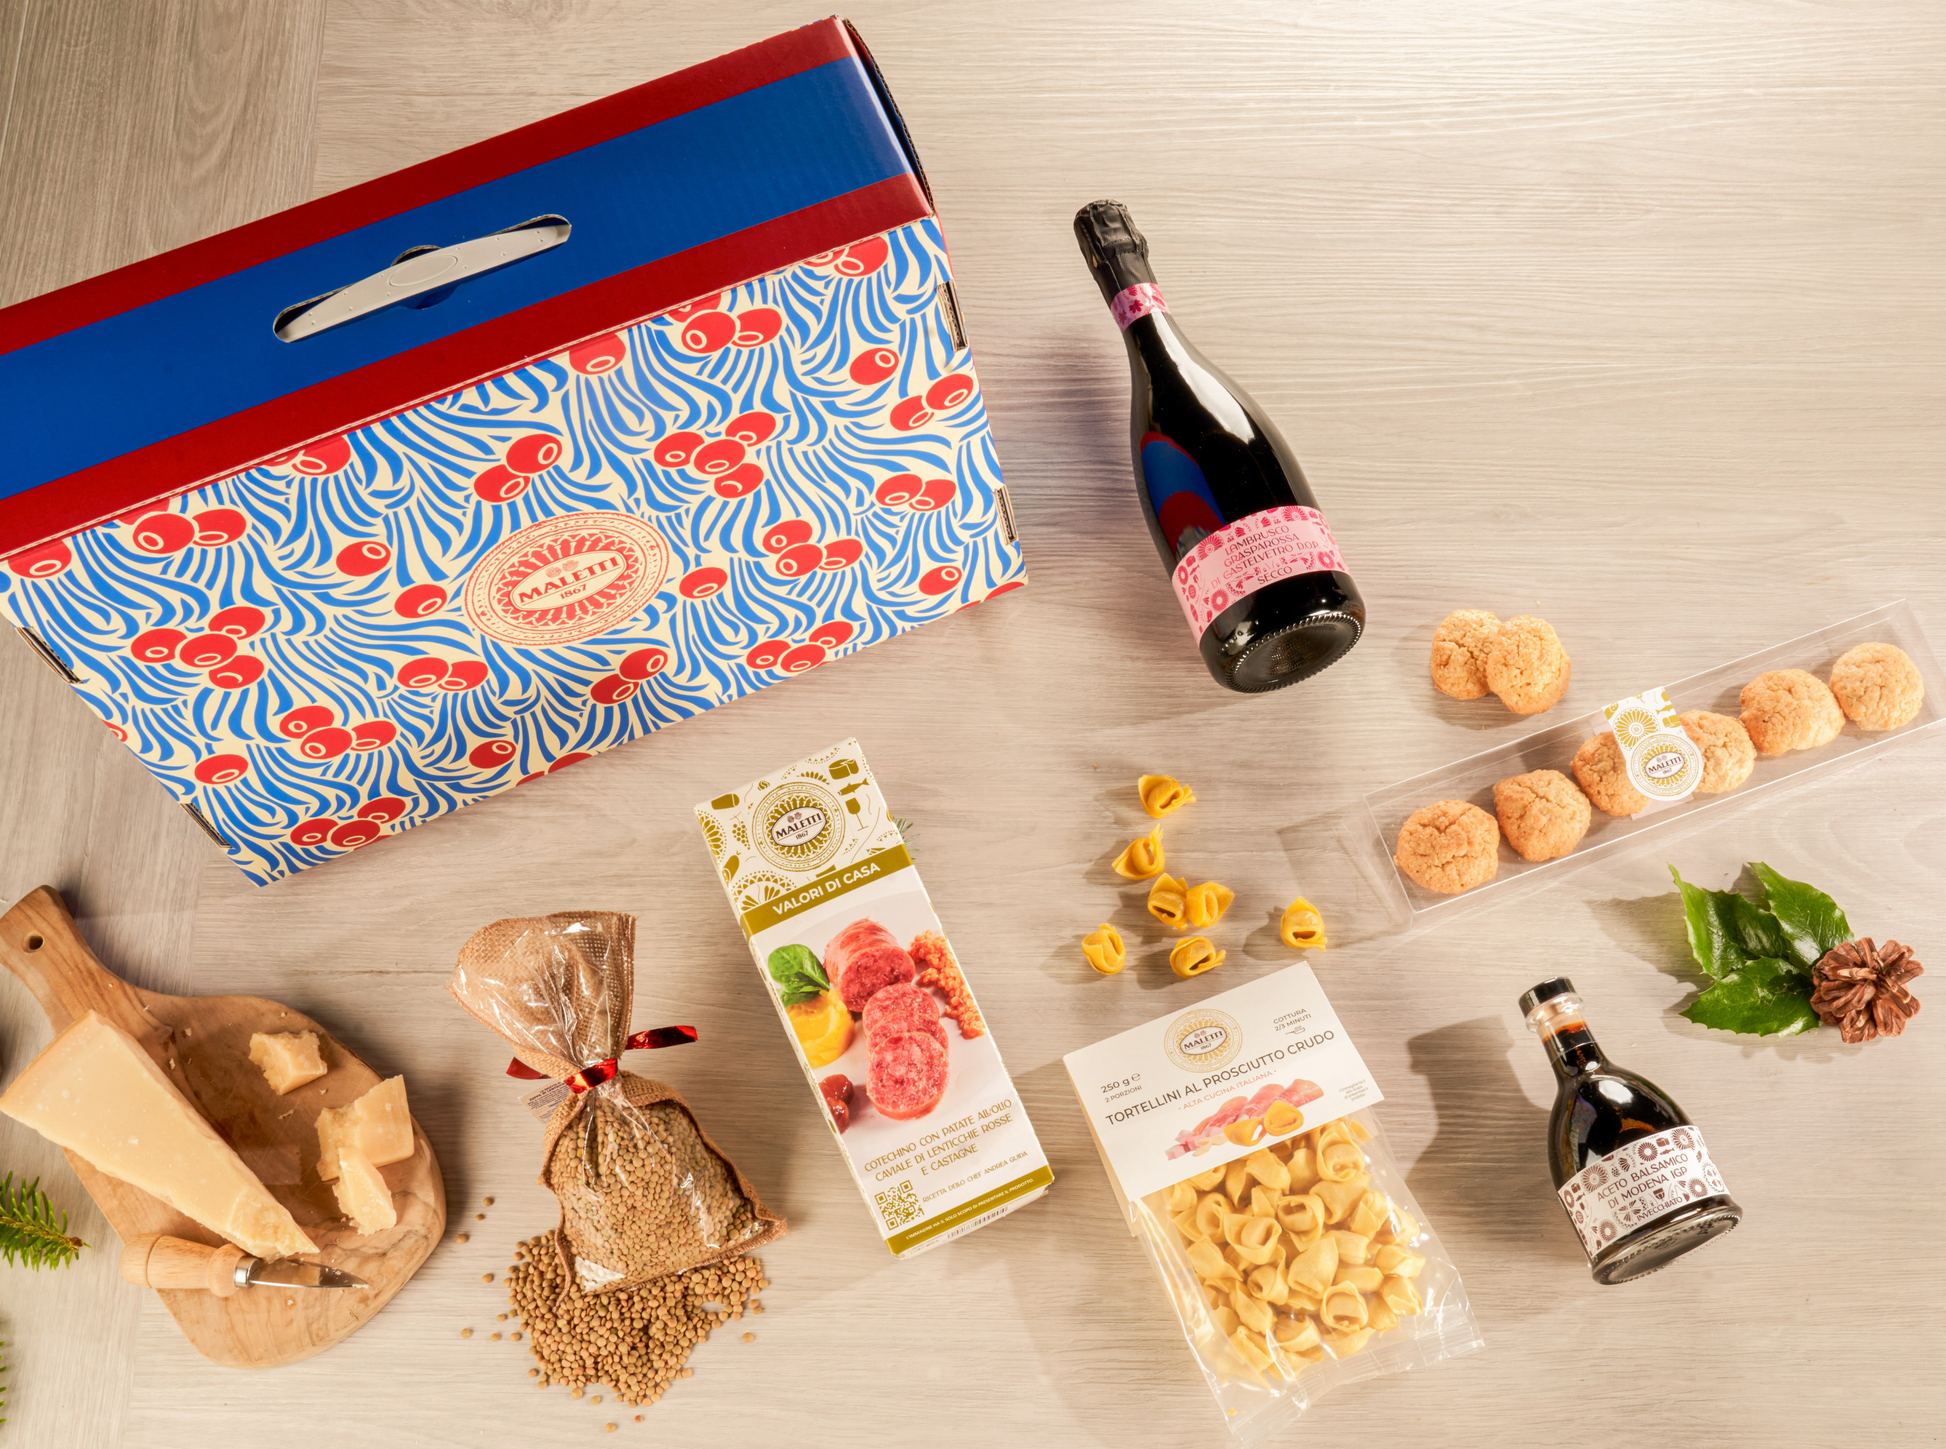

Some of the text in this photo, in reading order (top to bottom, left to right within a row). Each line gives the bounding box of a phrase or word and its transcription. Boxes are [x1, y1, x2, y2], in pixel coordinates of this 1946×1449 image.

[1223, 533, 1300, 568] GRASPAROSSA
[1225, 525, 1290, 556] LAMBRUSCO
[518, 556, 621, 604] MALETTI
[1211, 578, 1221, 589] DI
[1222, 544, 1294, 580] CASTELVETRO
[1257, 566, 1293, 585] SECCO
[559, 584, 587, 600] 1867
[1648, 756, 1682, 773] MALETTI
[775, 812, 822, 839] MALETTI
[772, 862, 881, 915] VALORI DI CASA
[1273, 1008, 1307, 1024] COTTURA
[1286, 1013, 1312, 1027] MINUTI
[1184, 1030, 1223, 1050] MALETTI
[1101, 1081, 1120, 1093] 250
[1122, 1078, 1130, 1087] g
[1105, 1029, 1335, 1126] TORTELLINI AL PROSCIUTTO CRUDO
[1110, 1085, 1143, 1101] PORZIONI
[1183, 1071, 1274, 1111] ALTA CUCINA ITALIANA
[863, 1142, 917, 1173] COTECHINO
[919, 1130, 941, 1147] CON
[941, 1115, 976, 1137] PATATE
[874, 1112, 1013, 1182] CAVIALE DI LENTICCHIE ROSSE
[921, 1143, 979, 1175] E CASTAGNE
[922, 1188, 948, 1203] RICETTA
[966, 1171, 982, 1183] CHEF
[984, 1160, 1008, 1175] ANDREA
[1009, 1151, 1028, 1163] GUIDA
[1597, 1153, 1689, 1202] ACETO BALSAMICO
[1608, 1166, 1688, 1209] DI MODENA IGP
[905, 1224, 933, 1240] L'IMMAGINE
[933, 1220, 941, 1228] HA
[945, 1213, 958, 1222] SOLO
[957, 1206, 973, 1217] SCOPO
[978, 1192, 1005, 1207] PRESENTARE
[1637, 1196, 1683, 1222] INVECCHIATO
